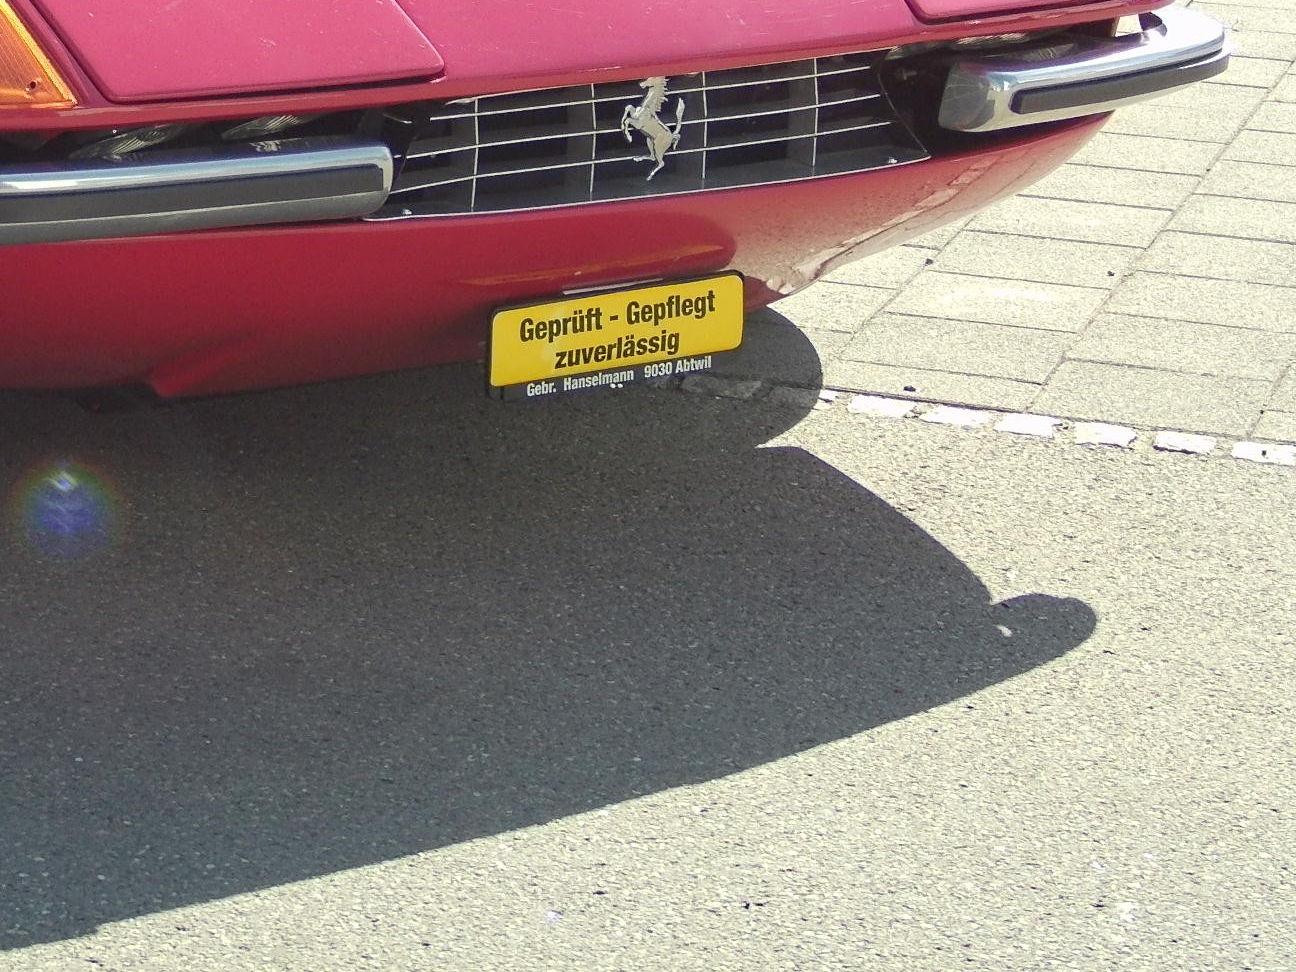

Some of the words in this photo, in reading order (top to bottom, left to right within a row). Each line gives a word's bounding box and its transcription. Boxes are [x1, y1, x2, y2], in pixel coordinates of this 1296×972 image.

[520, 307, 602, 343] Geprüft
[626, 289, 715, 326] Gepflegt
[554, 329, 680, 370] zuverlässig
[526, 381, 557, 397] Gebr.
[563, 369, 634, 391] Hanselmann
[644, 361, 673, 378] 9030
[675, 355, 712, 374] Abtwil
